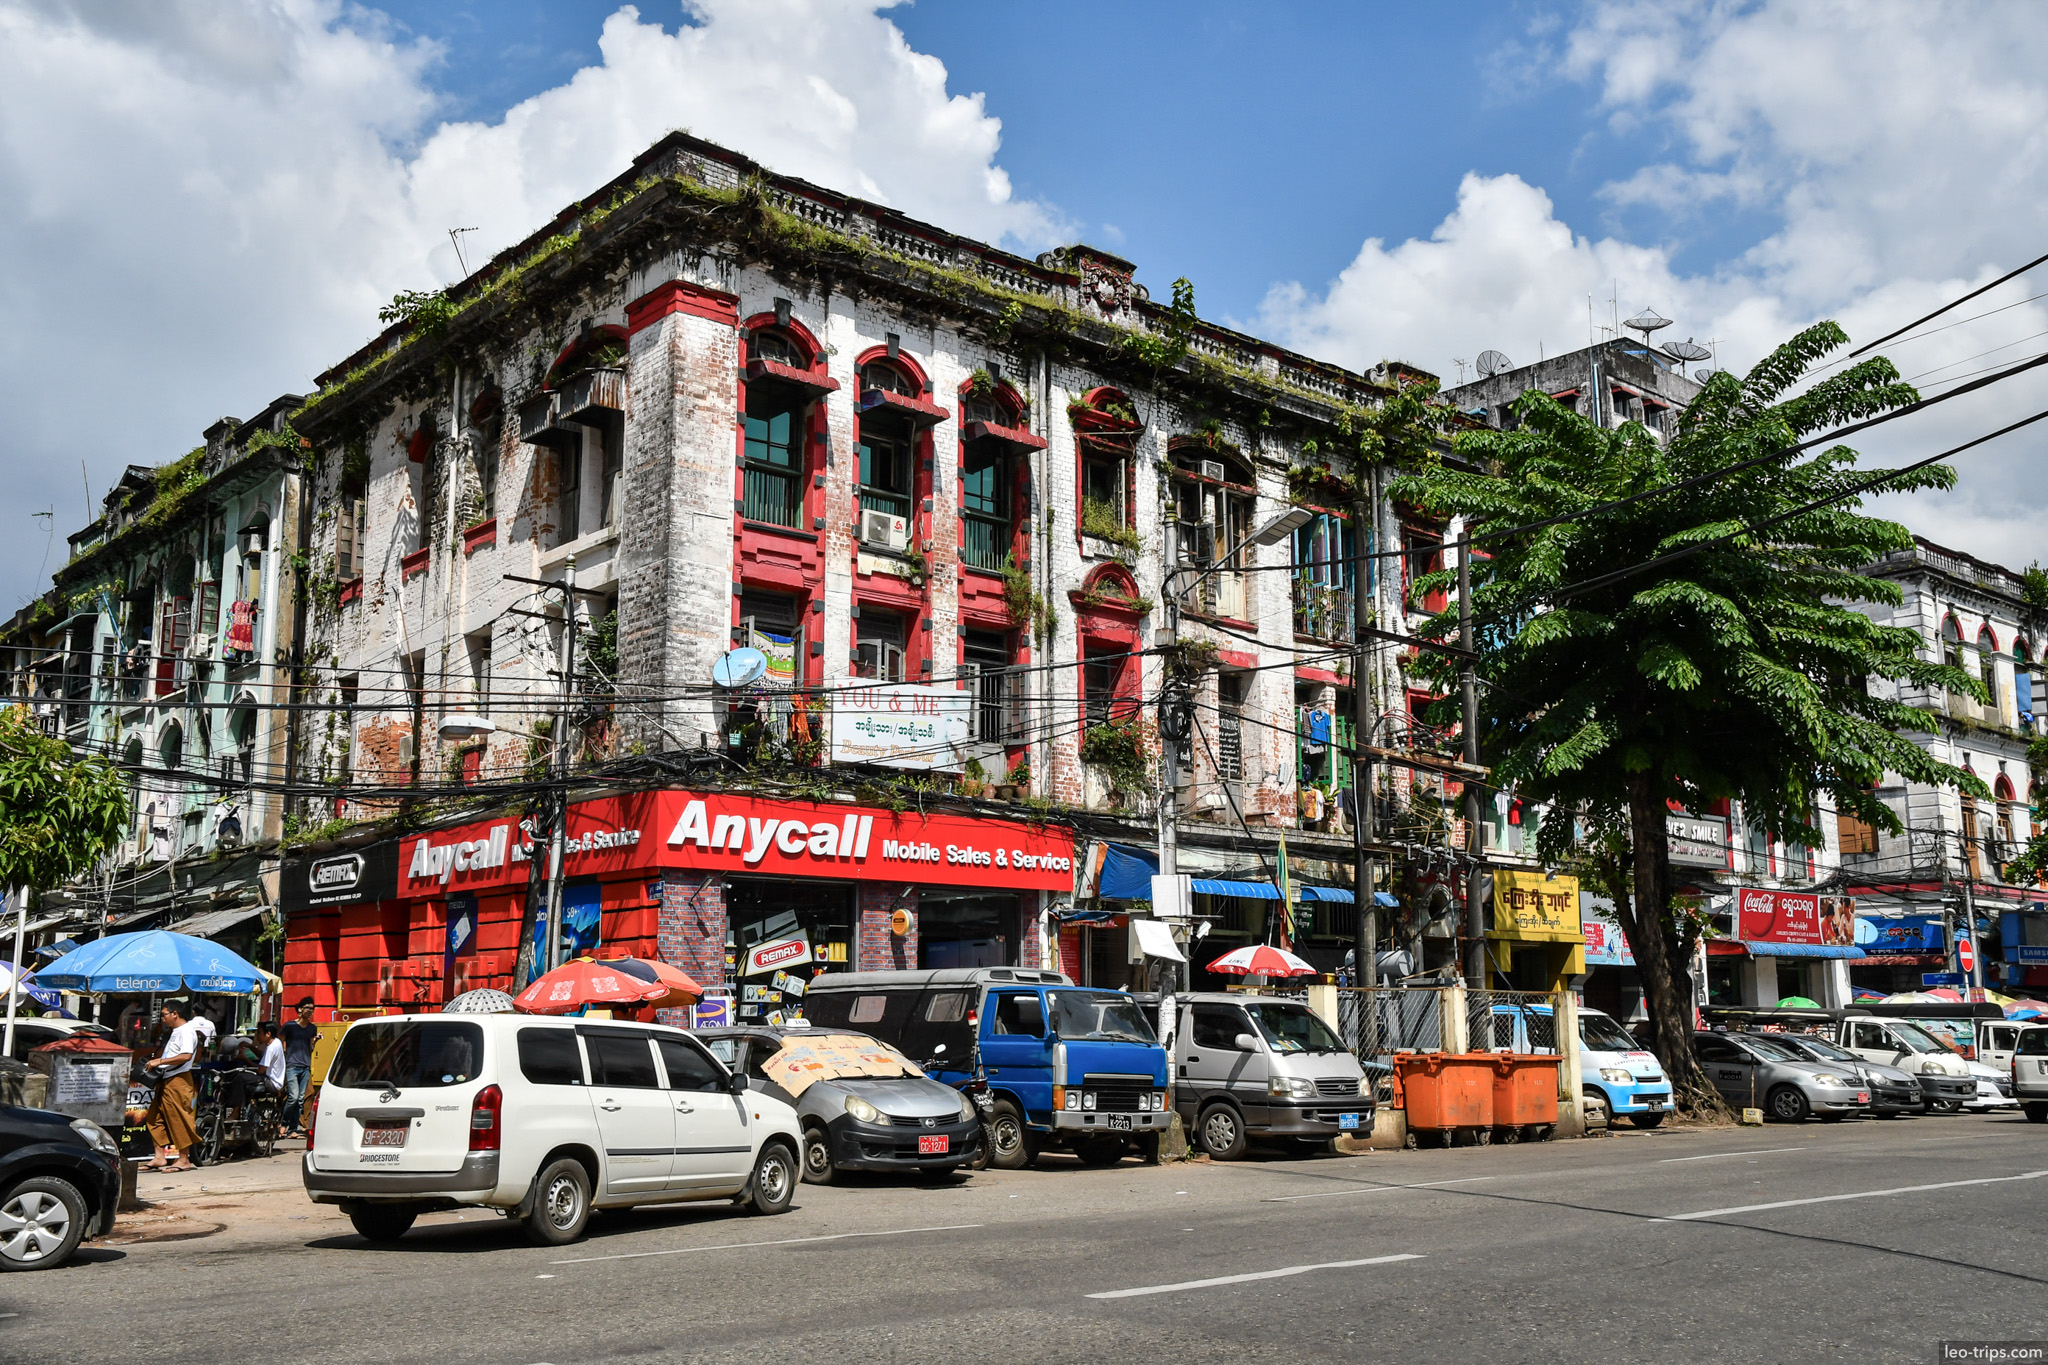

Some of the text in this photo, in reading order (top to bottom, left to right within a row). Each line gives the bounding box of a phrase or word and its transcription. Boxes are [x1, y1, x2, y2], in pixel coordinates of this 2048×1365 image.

[838, 681, 941, 717] YOU & ME
[840, 739, 888, 760] Beauty
[666, 800, 1071, 872] Anycall Mobile Sales & Service
[1692, 825, 1718, 842] SMILE
[407, 824, 509, 885] Anycall
[582, 832, 592, 851] &
[593, 827, 640, 850] Service
[761, 944, 798, 964] REMAX
[2023, 949, 2048, 957] SAMS
[115, 976, 163, 990] telenor
[364, 1130, 405, 1145] 9F-2320
[920, 1141, 946, 1152] CC-1271
[359, 1153, 400, 1163] BRIDGESTONE
